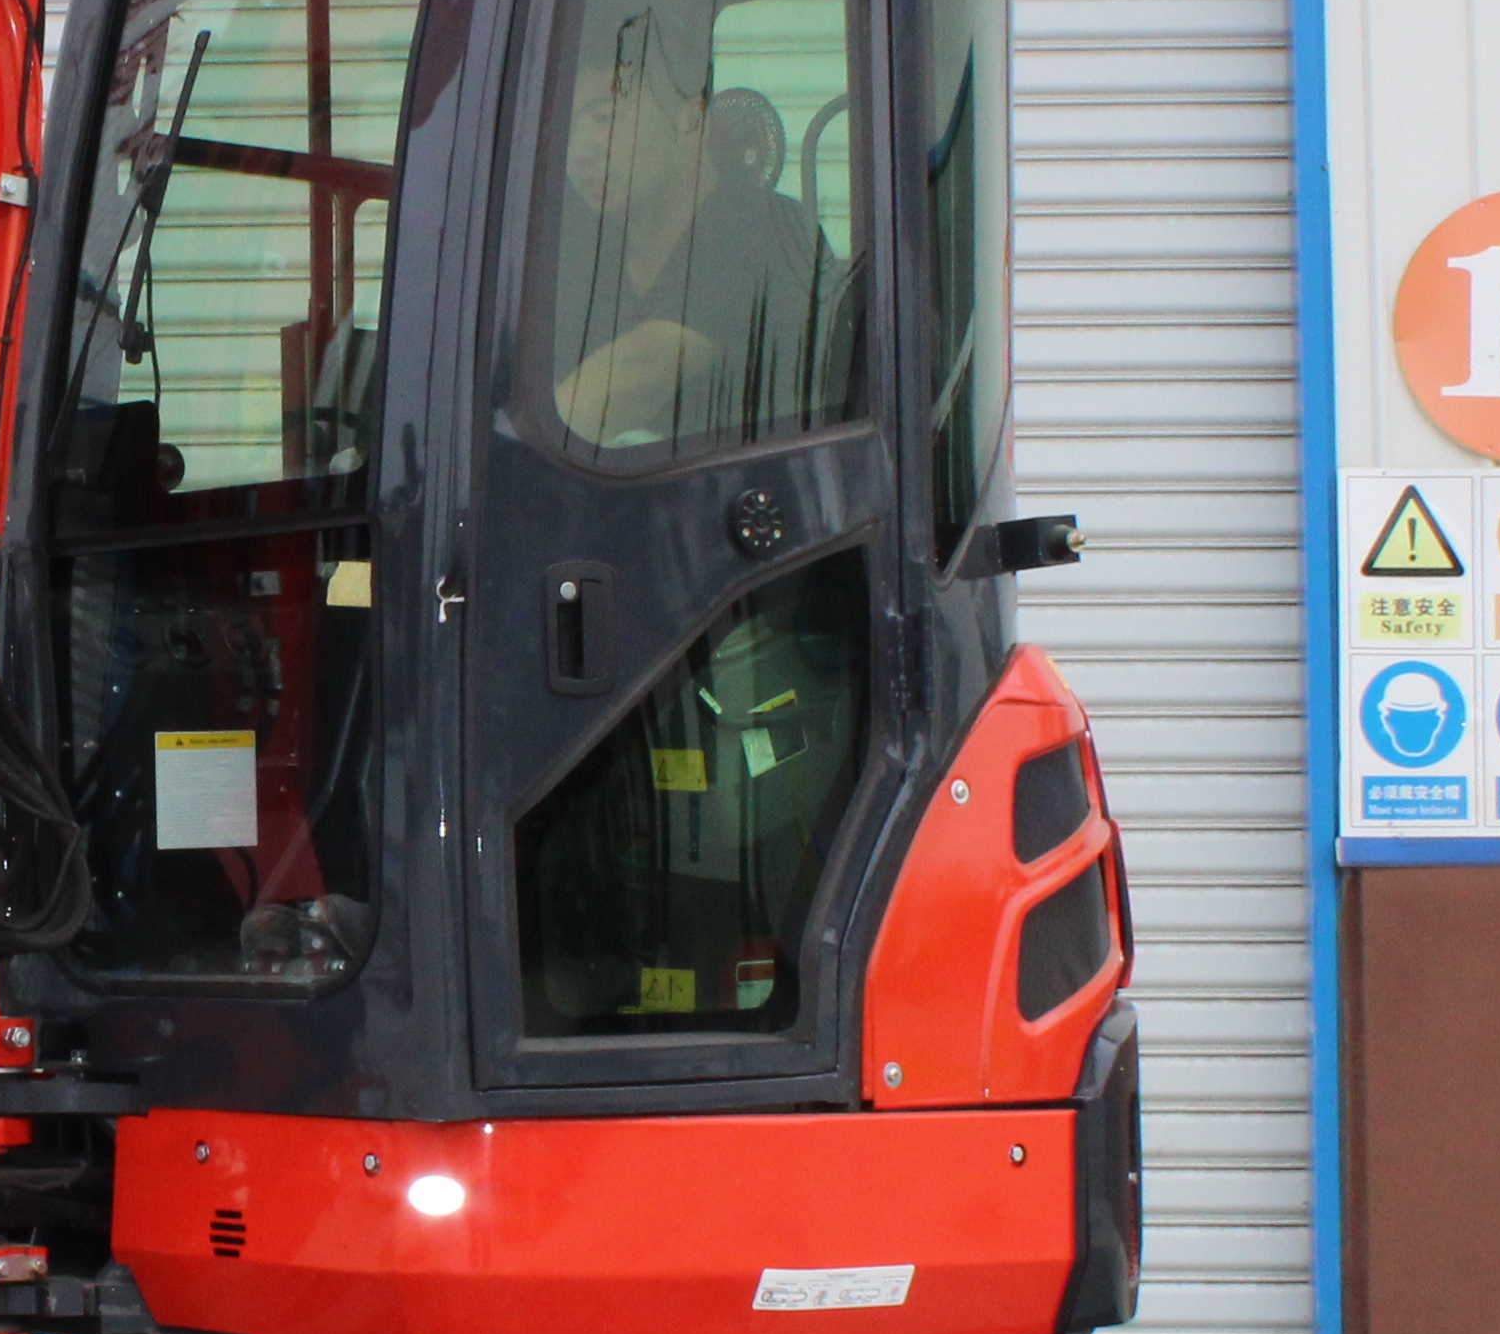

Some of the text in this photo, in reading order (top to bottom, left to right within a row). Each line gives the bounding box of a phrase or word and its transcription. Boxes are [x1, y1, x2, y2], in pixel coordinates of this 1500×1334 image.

[1370, 597, 1456, 618] 注意安全
[1380, 619, 1444, 637] Safety
